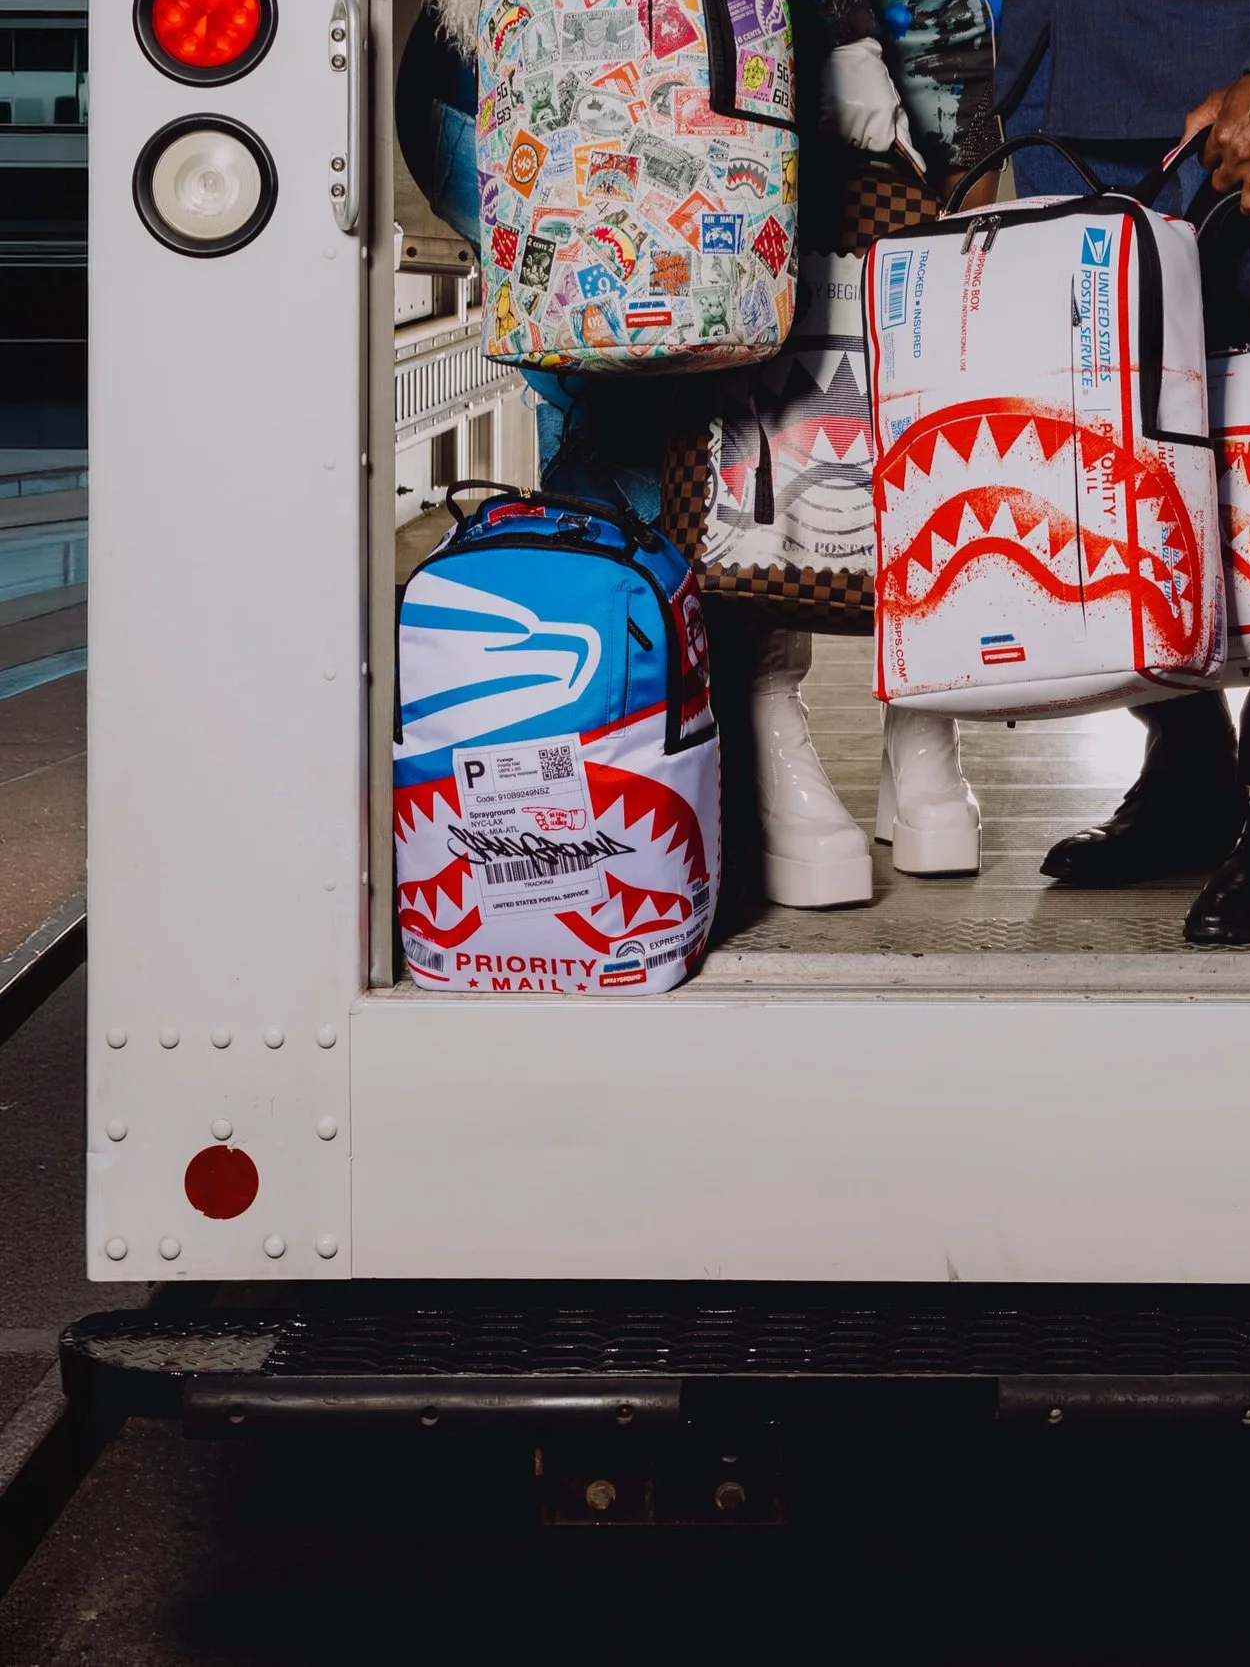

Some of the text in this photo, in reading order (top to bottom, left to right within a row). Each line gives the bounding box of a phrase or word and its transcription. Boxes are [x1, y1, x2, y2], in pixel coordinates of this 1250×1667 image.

[704, 214, 734, 224] AIR MAIL
[527, 237, 555, 253] 2 CENTS 2
[964, 259, 975, 287] DOMESTIC
[827, 282, 861, 301] BEGI
[962, 287, 971, 304] AND
[970, 289, 981, 312] BOX
[913, 249, 930, 359] TRACKED INSURED
[960, 305, 968, 357] INTERNATIONAL
[1080, 269, 1093, 388] POSTAL SERVICE
[1098, 272, 1112, 383] UNITED STATES
[464, 760, 486, 789] P
[476, 795, 497, 804] Code:
[469, 807, 516, 819] Sprayground
[471, 817, 504, 829] NYC-LAX
[524, 878, 554, 889] TRACKING
[492, 889, 590, 910] UNITED STATES POSTAL SERVICE
[649, 932, 686, 951] EXPRESS
[455, 952, 597, 977] PRIORITY
[491, 977, 565, 992] MAIL
